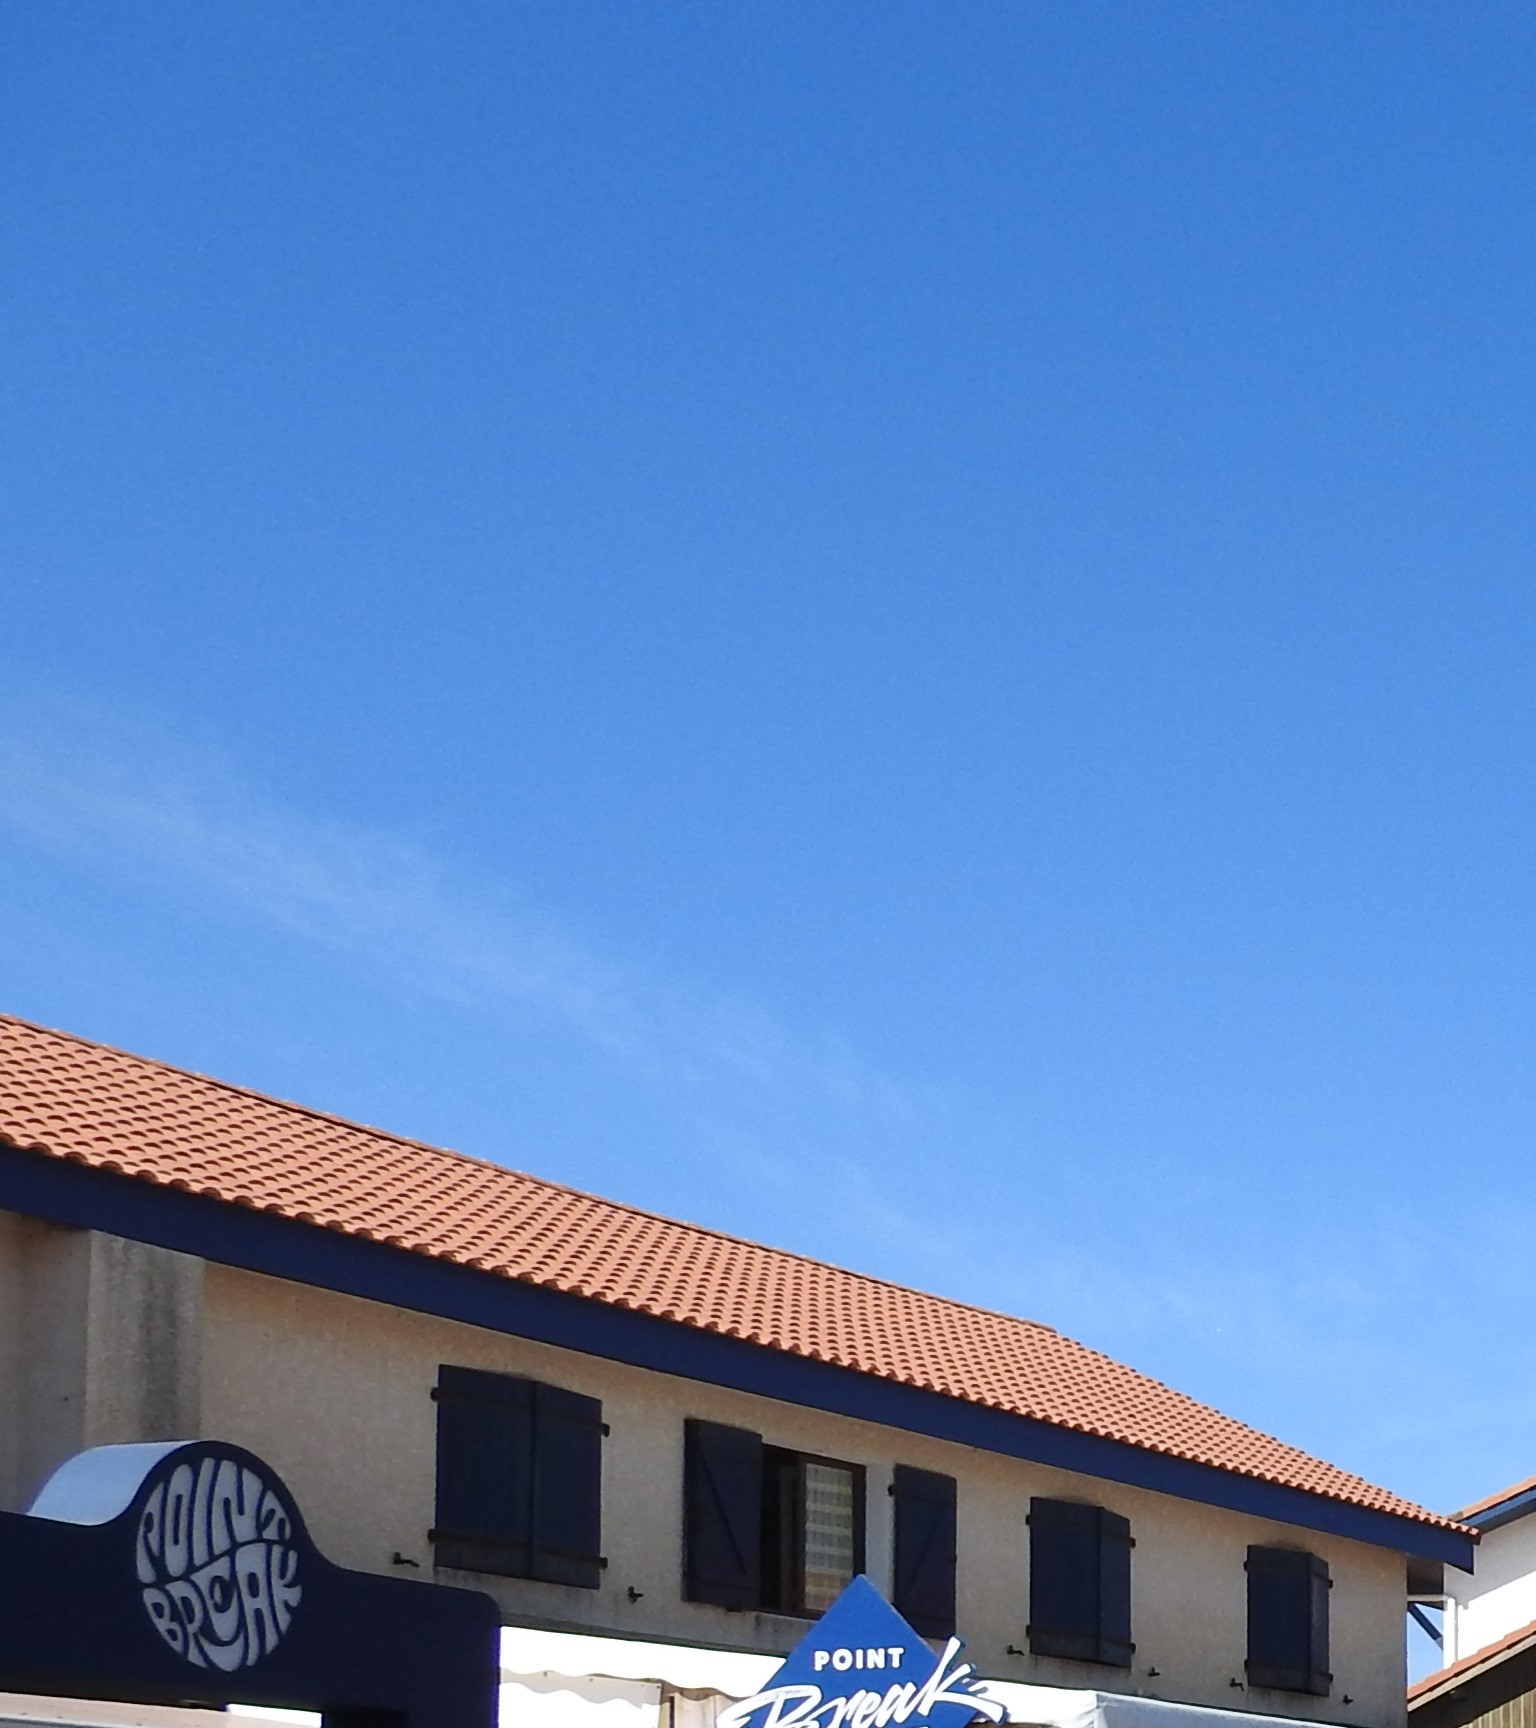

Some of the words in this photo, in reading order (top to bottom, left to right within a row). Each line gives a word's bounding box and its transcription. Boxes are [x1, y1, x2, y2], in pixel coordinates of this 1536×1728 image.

[136, 1457, 292, 1584] POINT
[143, 1543, 302, 1672] BREAK
[814, 1648, 905, 1672] POINT
